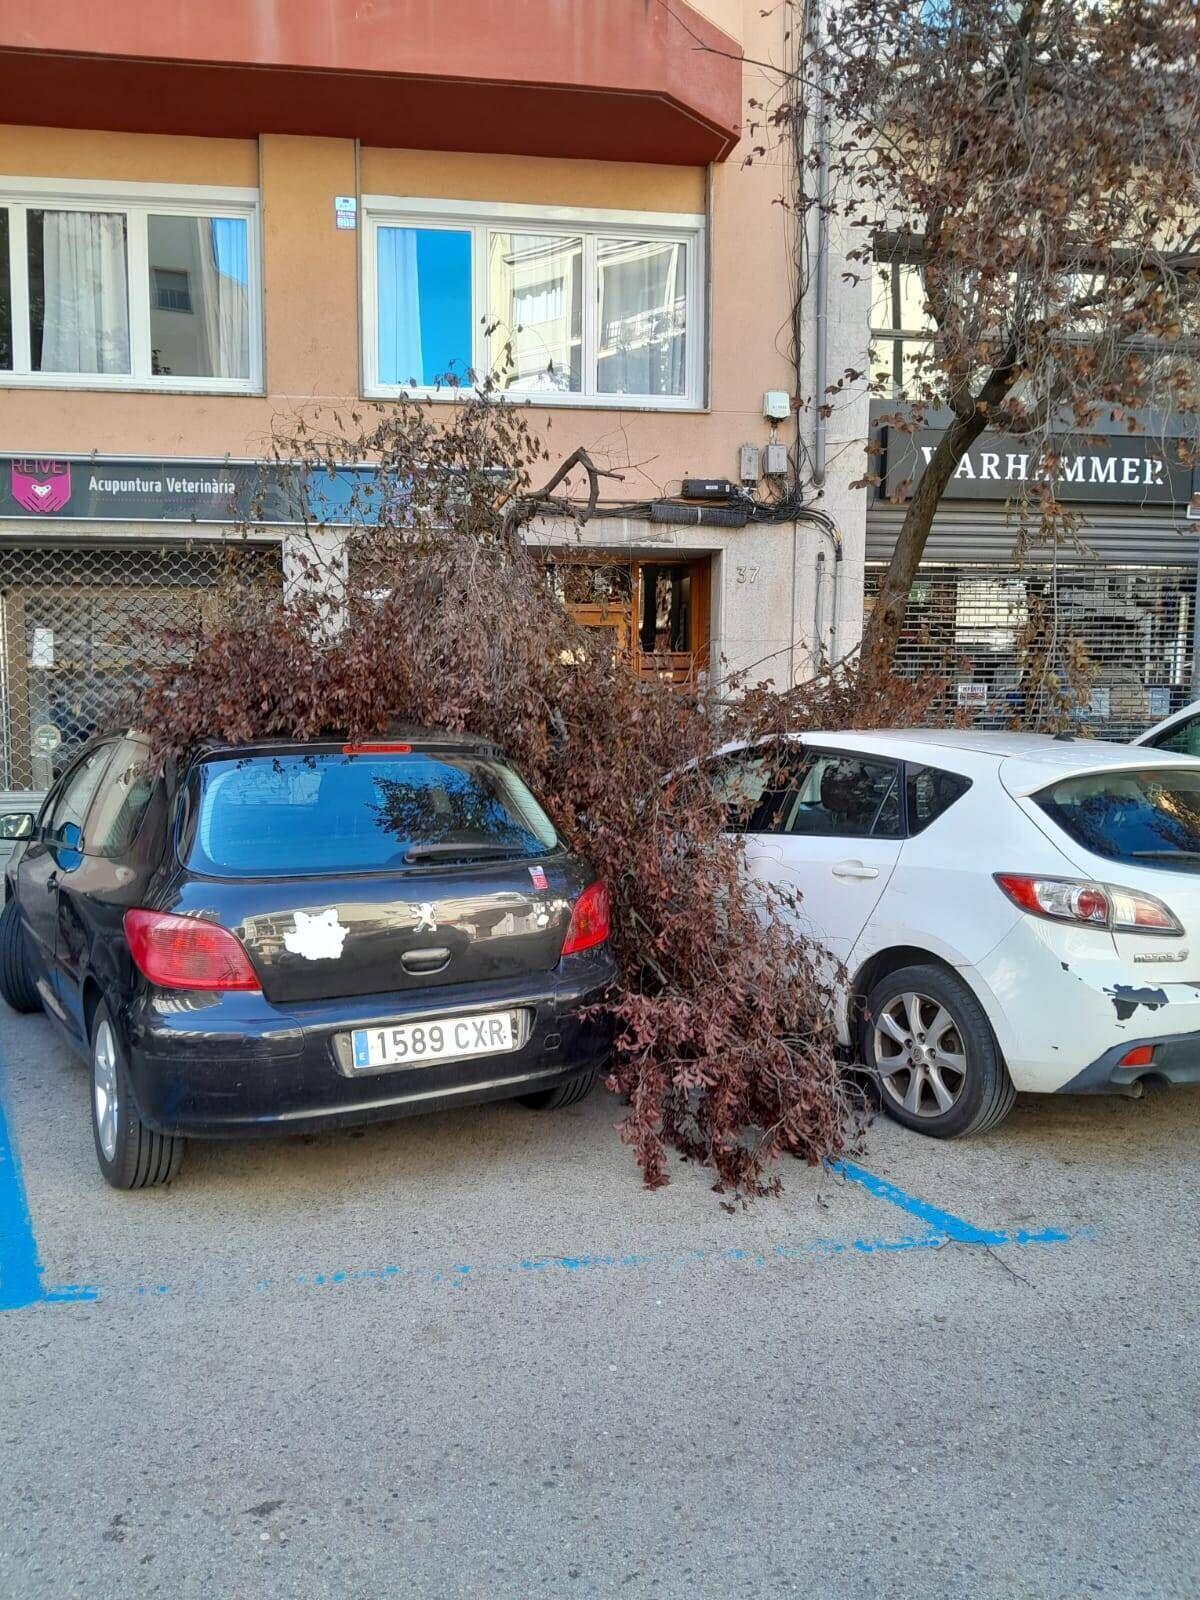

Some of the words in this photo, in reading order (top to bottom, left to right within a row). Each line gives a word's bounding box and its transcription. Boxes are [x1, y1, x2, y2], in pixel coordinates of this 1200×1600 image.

[88, 475, 162, 495] Acupuntura
[166, 477, 236, 494] Veterinària
[736, 566, 760, 584] 37
[359, 1052, 367, 1061] E
[377, 1026, 444, 1059] 1589
[454, 1019, 504, 1049] CXR
